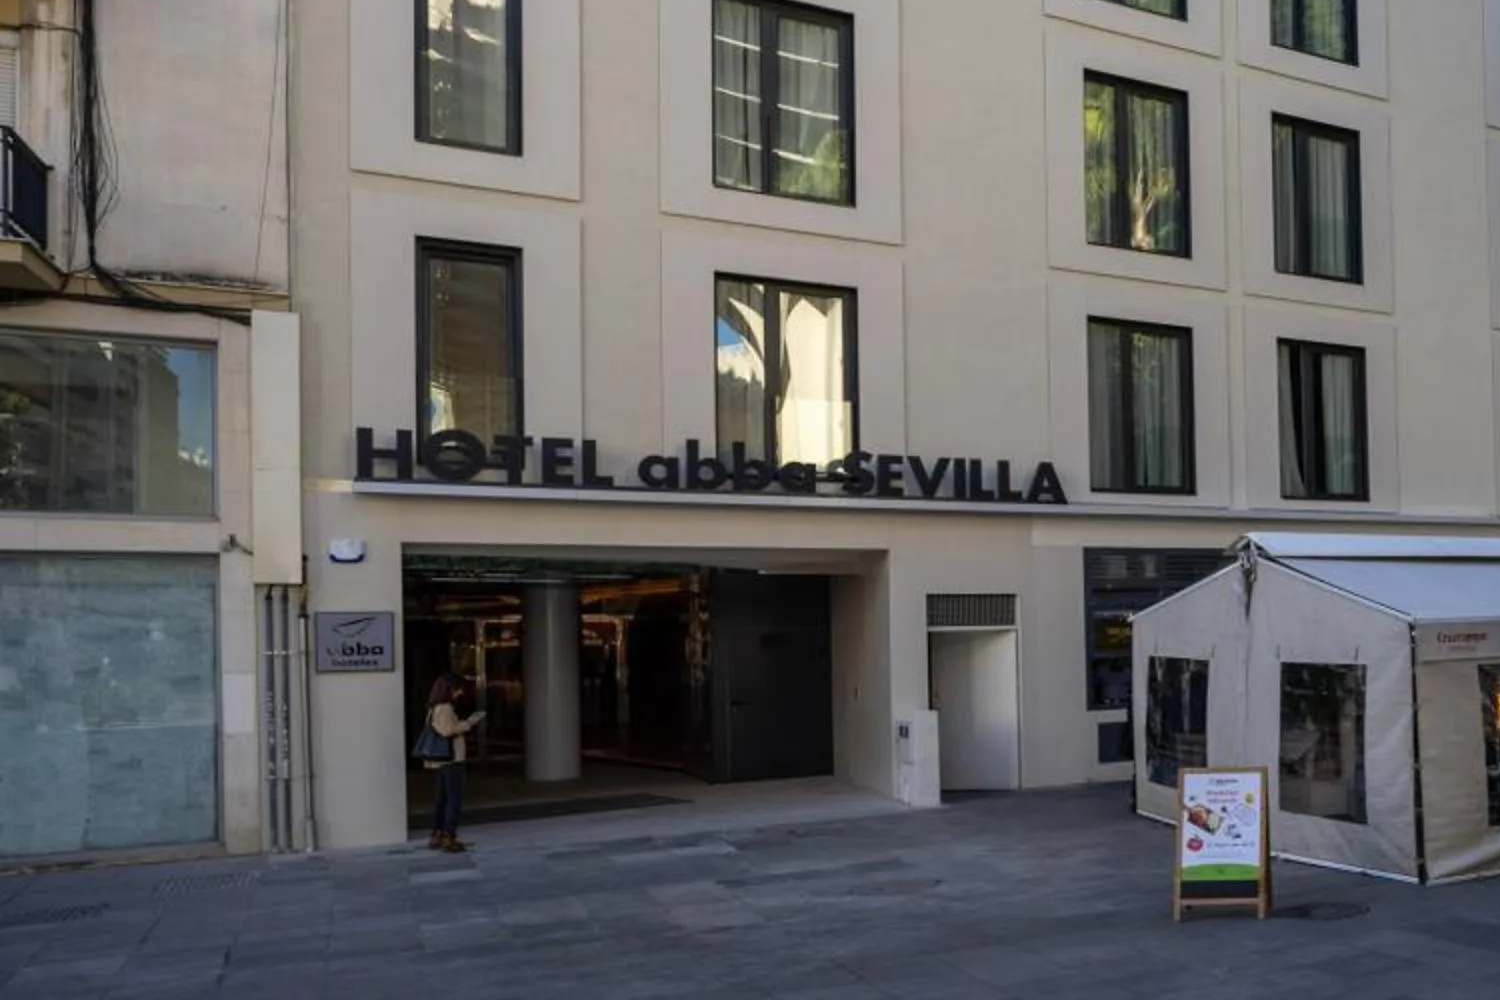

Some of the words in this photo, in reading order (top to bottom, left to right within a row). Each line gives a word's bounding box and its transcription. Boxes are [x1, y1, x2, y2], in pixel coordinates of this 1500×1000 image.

[355, 427, 614, 487] HOTEL
[637, 439, 817, 493] abba
[842, 450, 1069, 505] SEVILLA
